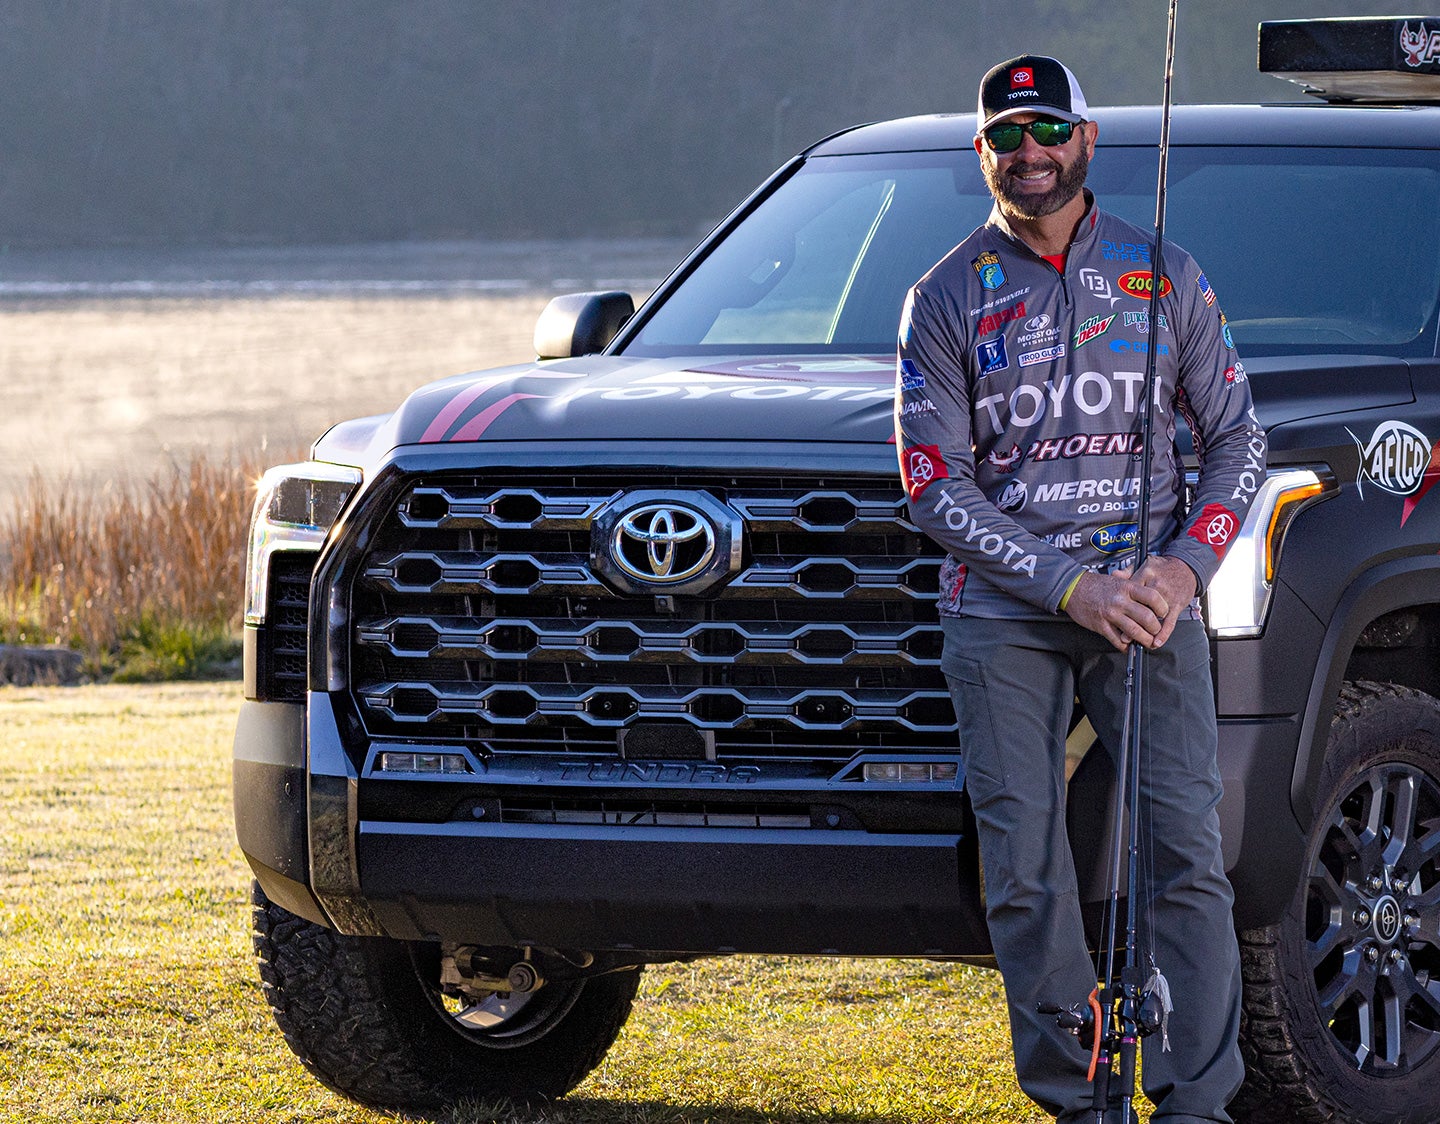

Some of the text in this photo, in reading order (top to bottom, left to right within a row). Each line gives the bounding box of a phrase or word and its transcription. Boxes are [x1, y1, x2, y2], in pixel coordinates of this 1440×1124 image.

[1007, 90, 1039, 99] TOYOTA
[1101, 239, 1150, 253] DUDE
[1102, 252, 1151, 263] WIPES
[1086, 275, 1105, 291] 13
[995, 287, 1031, 306] SWINDLE
[1017, 330, 1044, 344] MOSSY
[1133, 341, 1169, 356] COTA
[1033, 476, 1153, 502] MERCUR
[1078, 505, 1100, 514] GO
[933, 489, 1038, 579] TOYOTA
[1098, 529, 1140, 546] Buckey
[558, 763, 761, 784] TUNDRA
